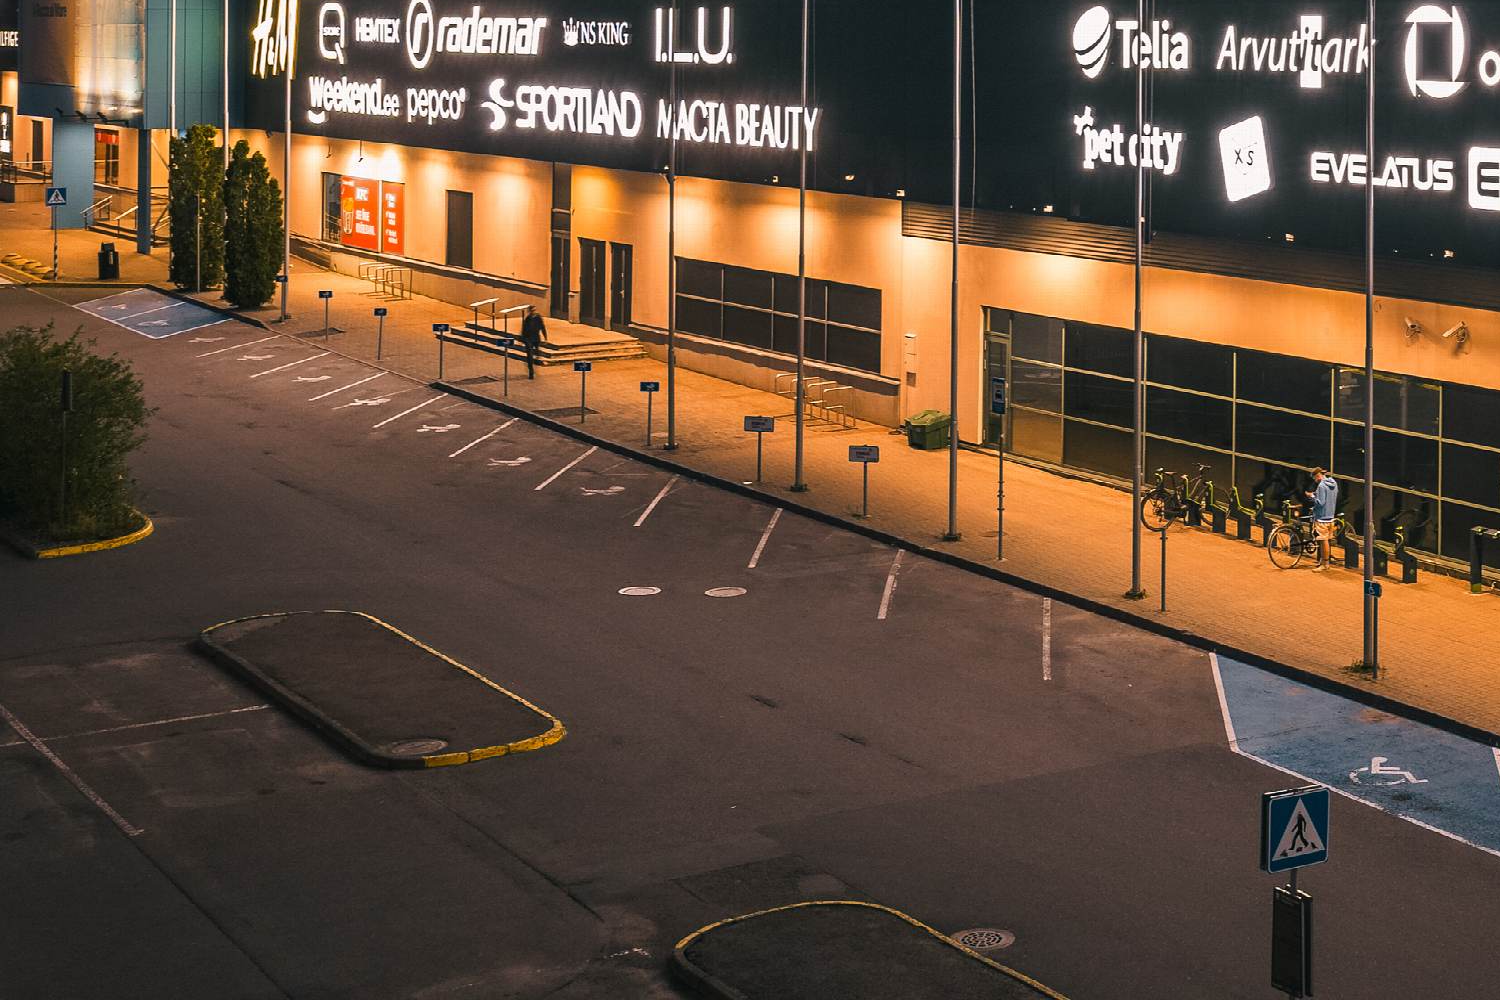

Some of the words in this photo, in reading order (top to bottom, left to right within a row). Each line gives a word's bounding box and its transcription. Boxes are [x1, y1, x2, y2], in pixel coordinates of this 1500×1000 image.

[354, 16, 401, 44] HEMTEX
[436, 5, 548, 55] rademar
[597, 21, 631, 46] KING
[1115, 19, 1190, 70] Telia
[406, 88, 463, 126] pepco
[515, 84, 643, 138] SPORTLAND
[735, 103, 819, 152] BEAUTY
[1082, 123, 1126, 170] pet
